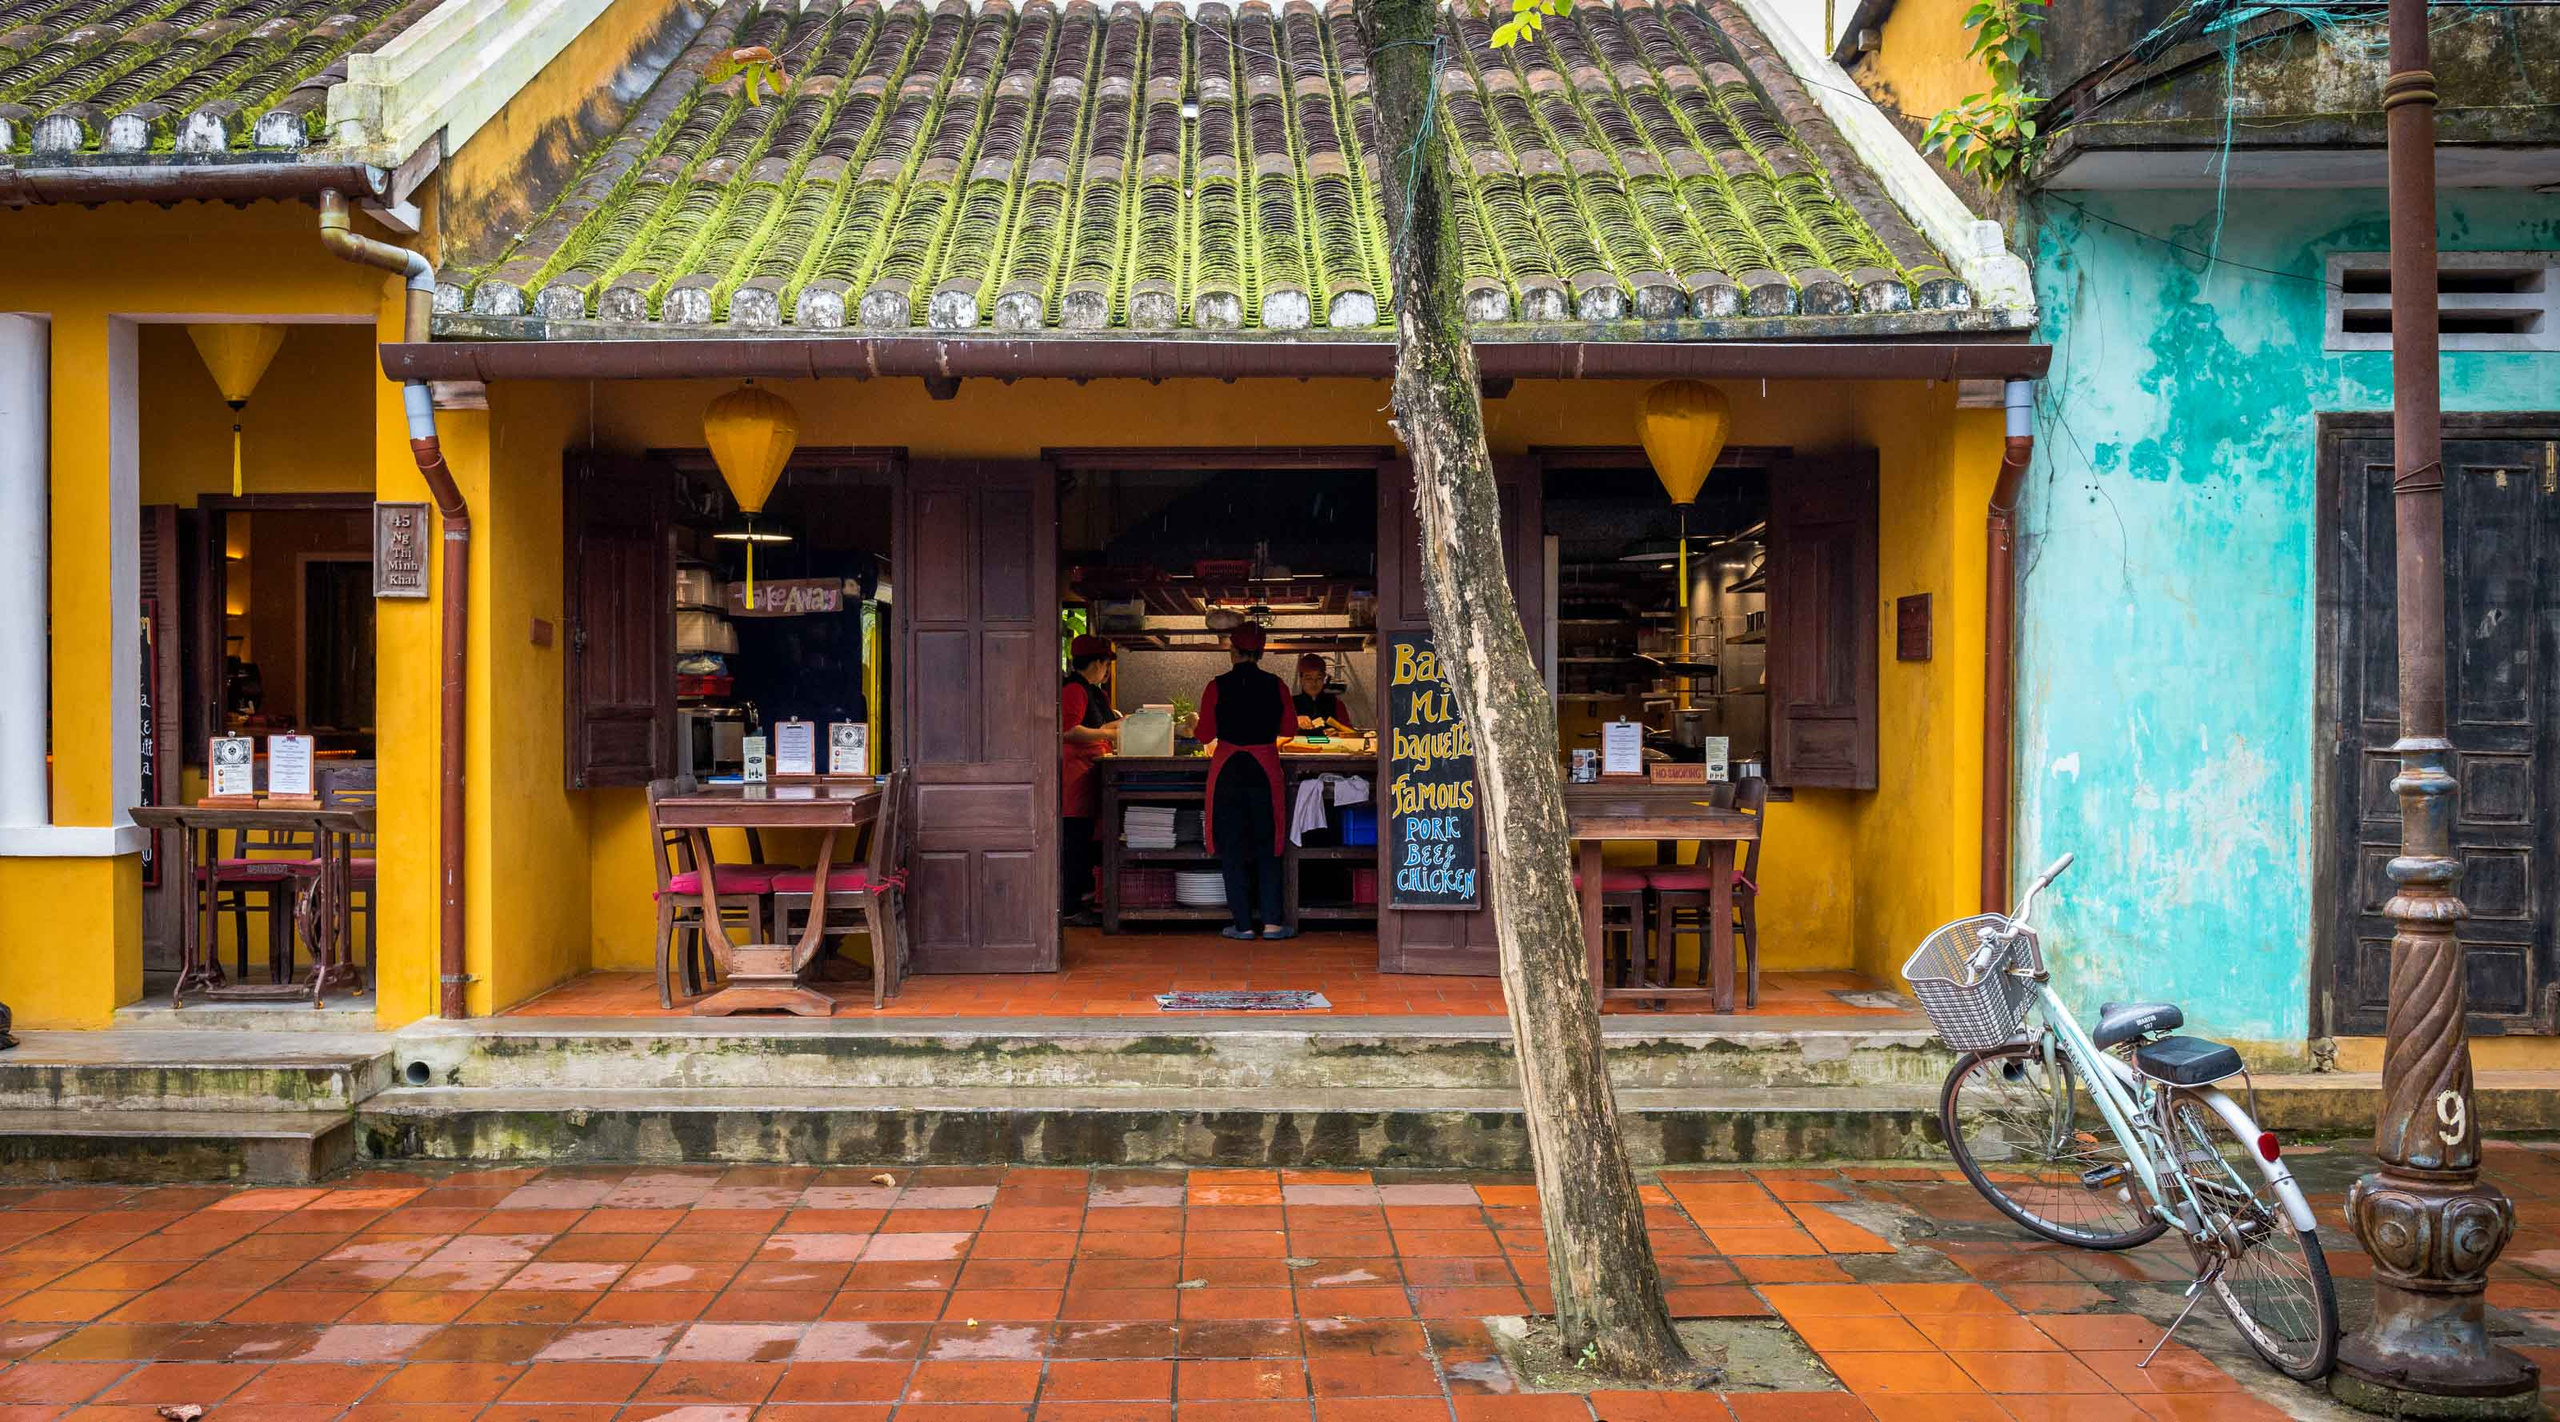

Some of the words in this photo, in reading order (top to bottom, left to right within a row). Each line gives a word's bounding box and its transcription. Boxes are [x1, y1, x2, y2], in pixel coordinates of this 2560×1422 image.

[394, 515, 411, 528] 45
[393, 531, 410, 545] Ng
[388, 560, 419, 572] Minh
[389, 574, 416, 586] Khai
[1391, 720, 1473, 773] baguette
[1655, 767, 1667, 779] NO
[1668, 767, 1702, 779] SMOKING
[1405, 816, 1461, 842] PORK
[2136, 1015, 2157, 1026] MARTIN
[2437, 1089, 2466, 1146] 9
